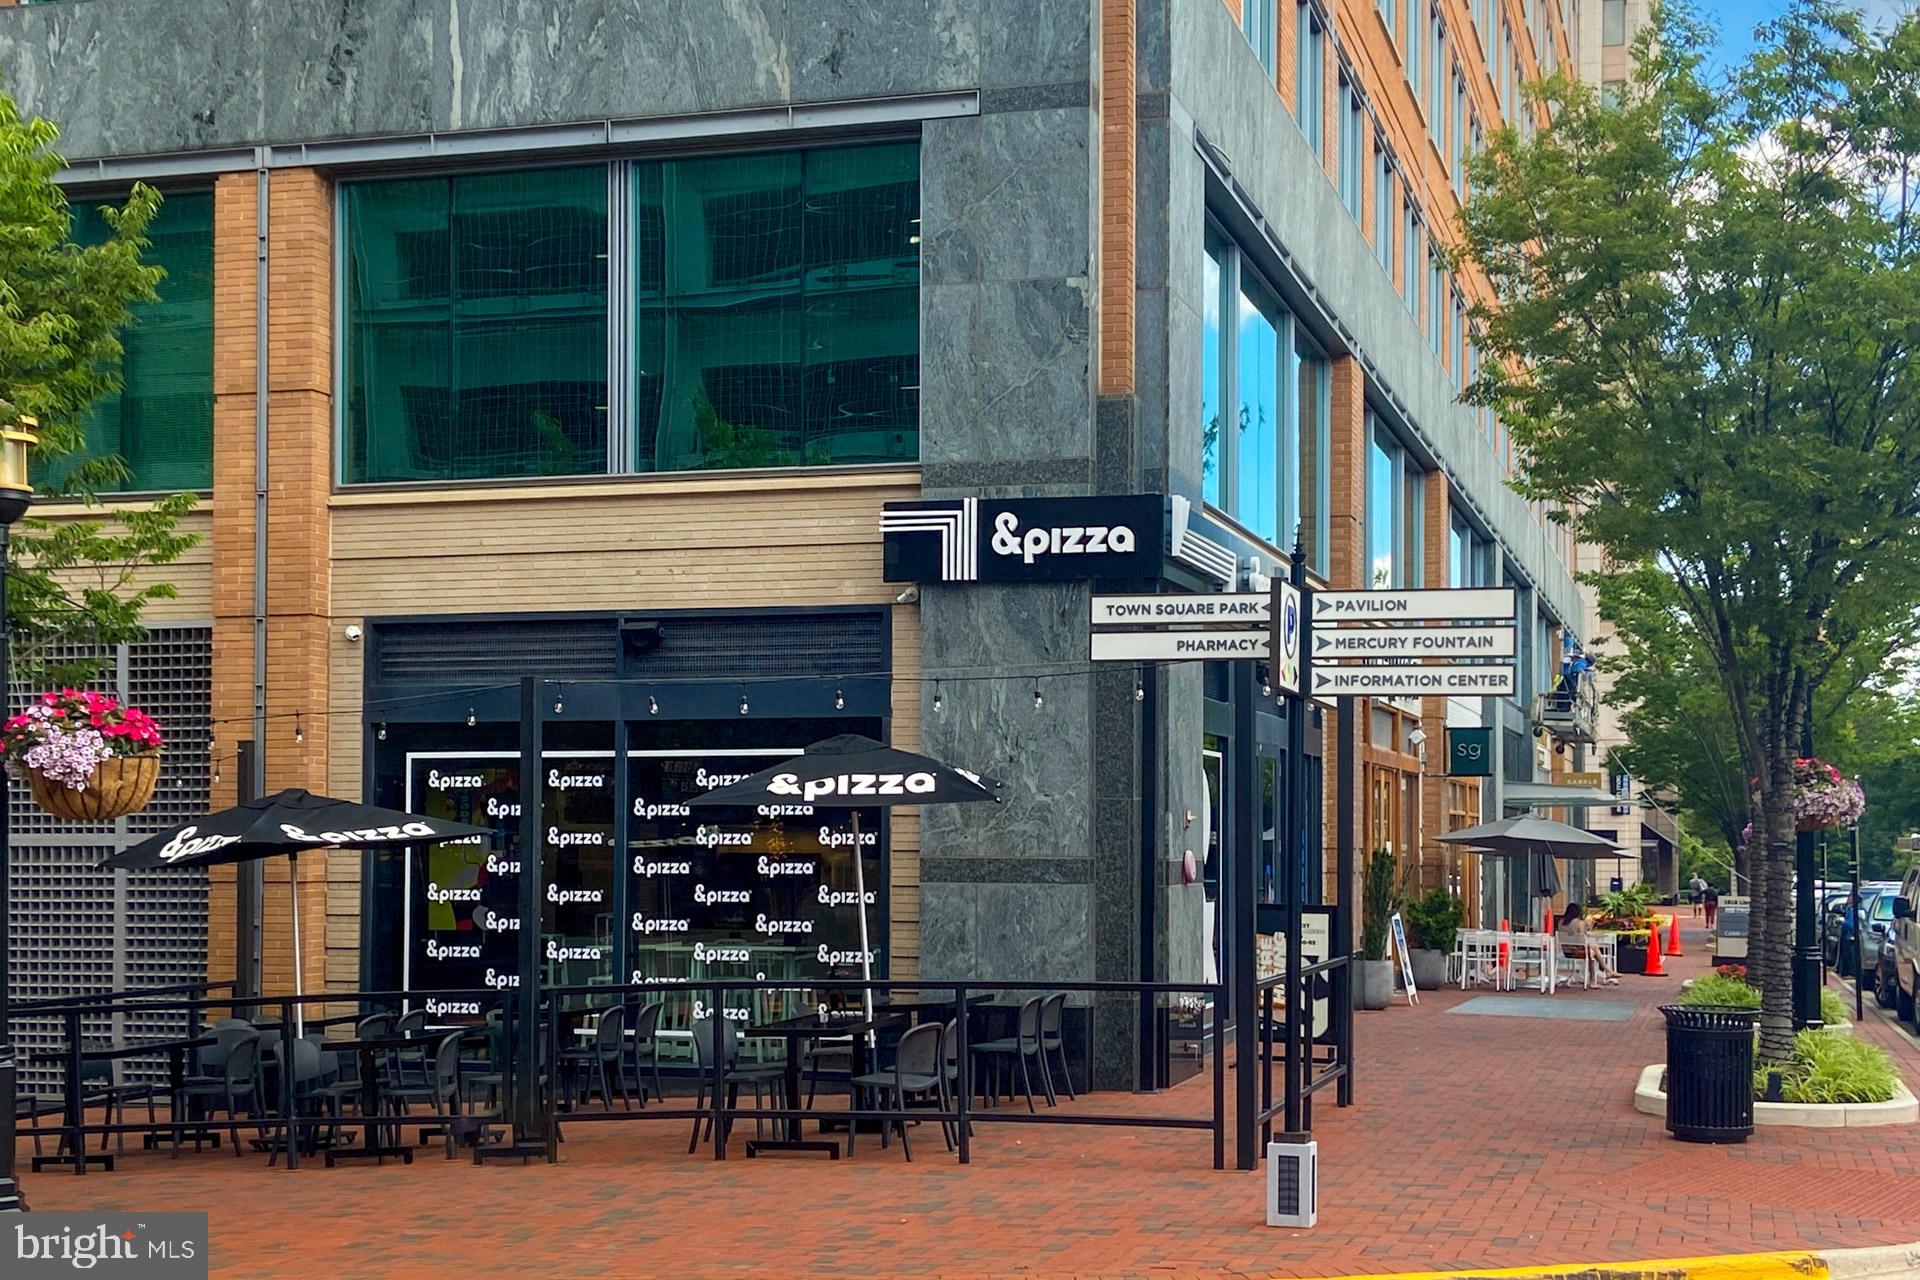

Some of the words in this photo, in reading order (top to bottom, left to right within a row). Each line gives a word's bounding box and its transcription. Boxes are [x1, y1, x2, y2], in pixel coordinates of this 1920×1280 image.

[992, 512, 1135, 563] &pizza
[1106, 603, 1151, 617] TOWN
[1156, 602, 1215, 616] SQUARE
[1220, 601, 1259, 615] PARK
[1335, 599, 1407, 612] PAVILION
[1176, 638, 1259, 652] PHARMACY
[1335, 636, 1408, 650] MERCURY
[1413, 635, 1493, 649] FOUNTAIN
[1334, 674, 1442, 687] INFORMATION
[1447, 674, 1508, 687] CENTER
[1457, 743, 1481, 760] sg
[429, 770, 482, 791] &pizza
[549, 769, 604, 791] &pizza
[767, 772, 937, 802] &pizza
[548, 827, 604, 848] &pizza
[696, 827, 753, 848] &pizza
[634, 856, 691, 878] &pizza
[758, 856, 815, 878] &pizza
[428, 883, 482, 904] &pizza
[548, 884, 604, 905] &pizza
[694, 884, 752, 906] &pizza
[632, 913, 689, 935] &pizza
[756, 914, 814, 936] &pizza
[427, 940, 481, 961] &pizza
[547, 941, 602, 962] &pizza
[694, 943, 752, 964] &pizza
